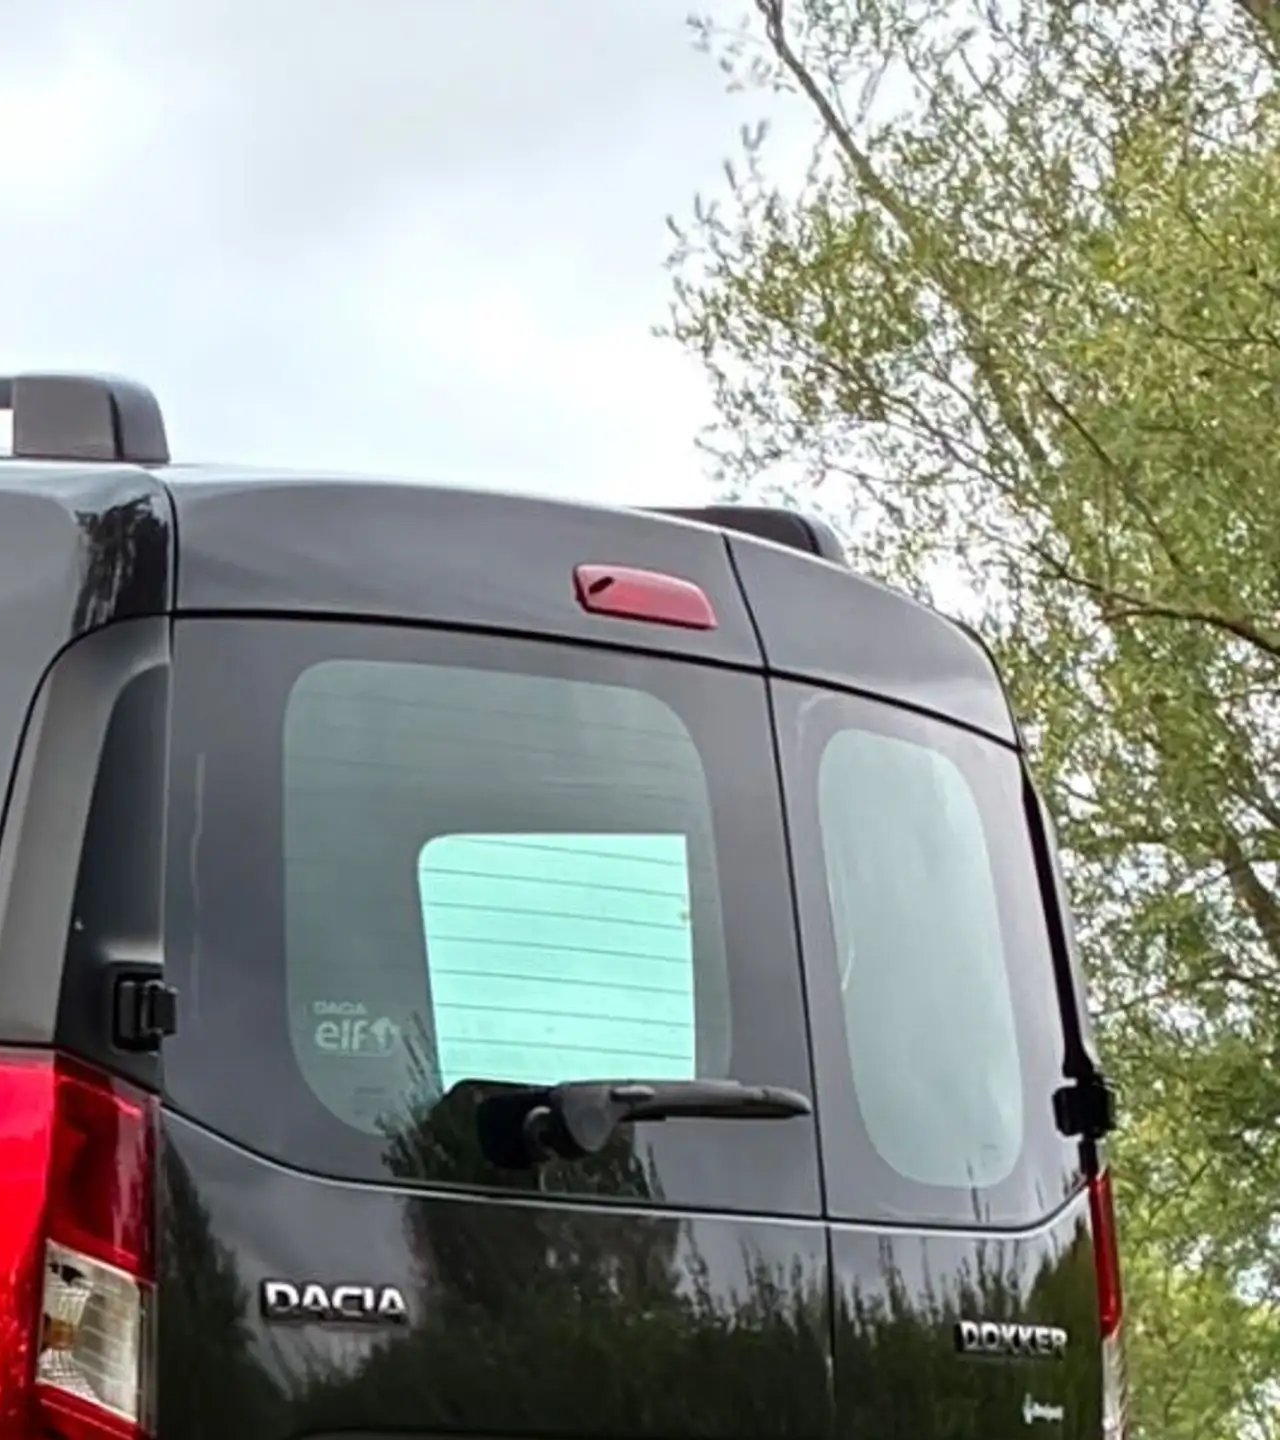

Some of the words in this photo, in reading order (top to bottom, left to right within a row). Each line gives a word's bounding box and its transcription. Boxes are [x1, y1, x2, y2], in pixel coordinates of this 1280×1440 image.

[315, 1019, 370, 1050] elf
[263, 1280, 407, 1318] DACIA
[959, 1320, 1068, 1356] DOKKER
